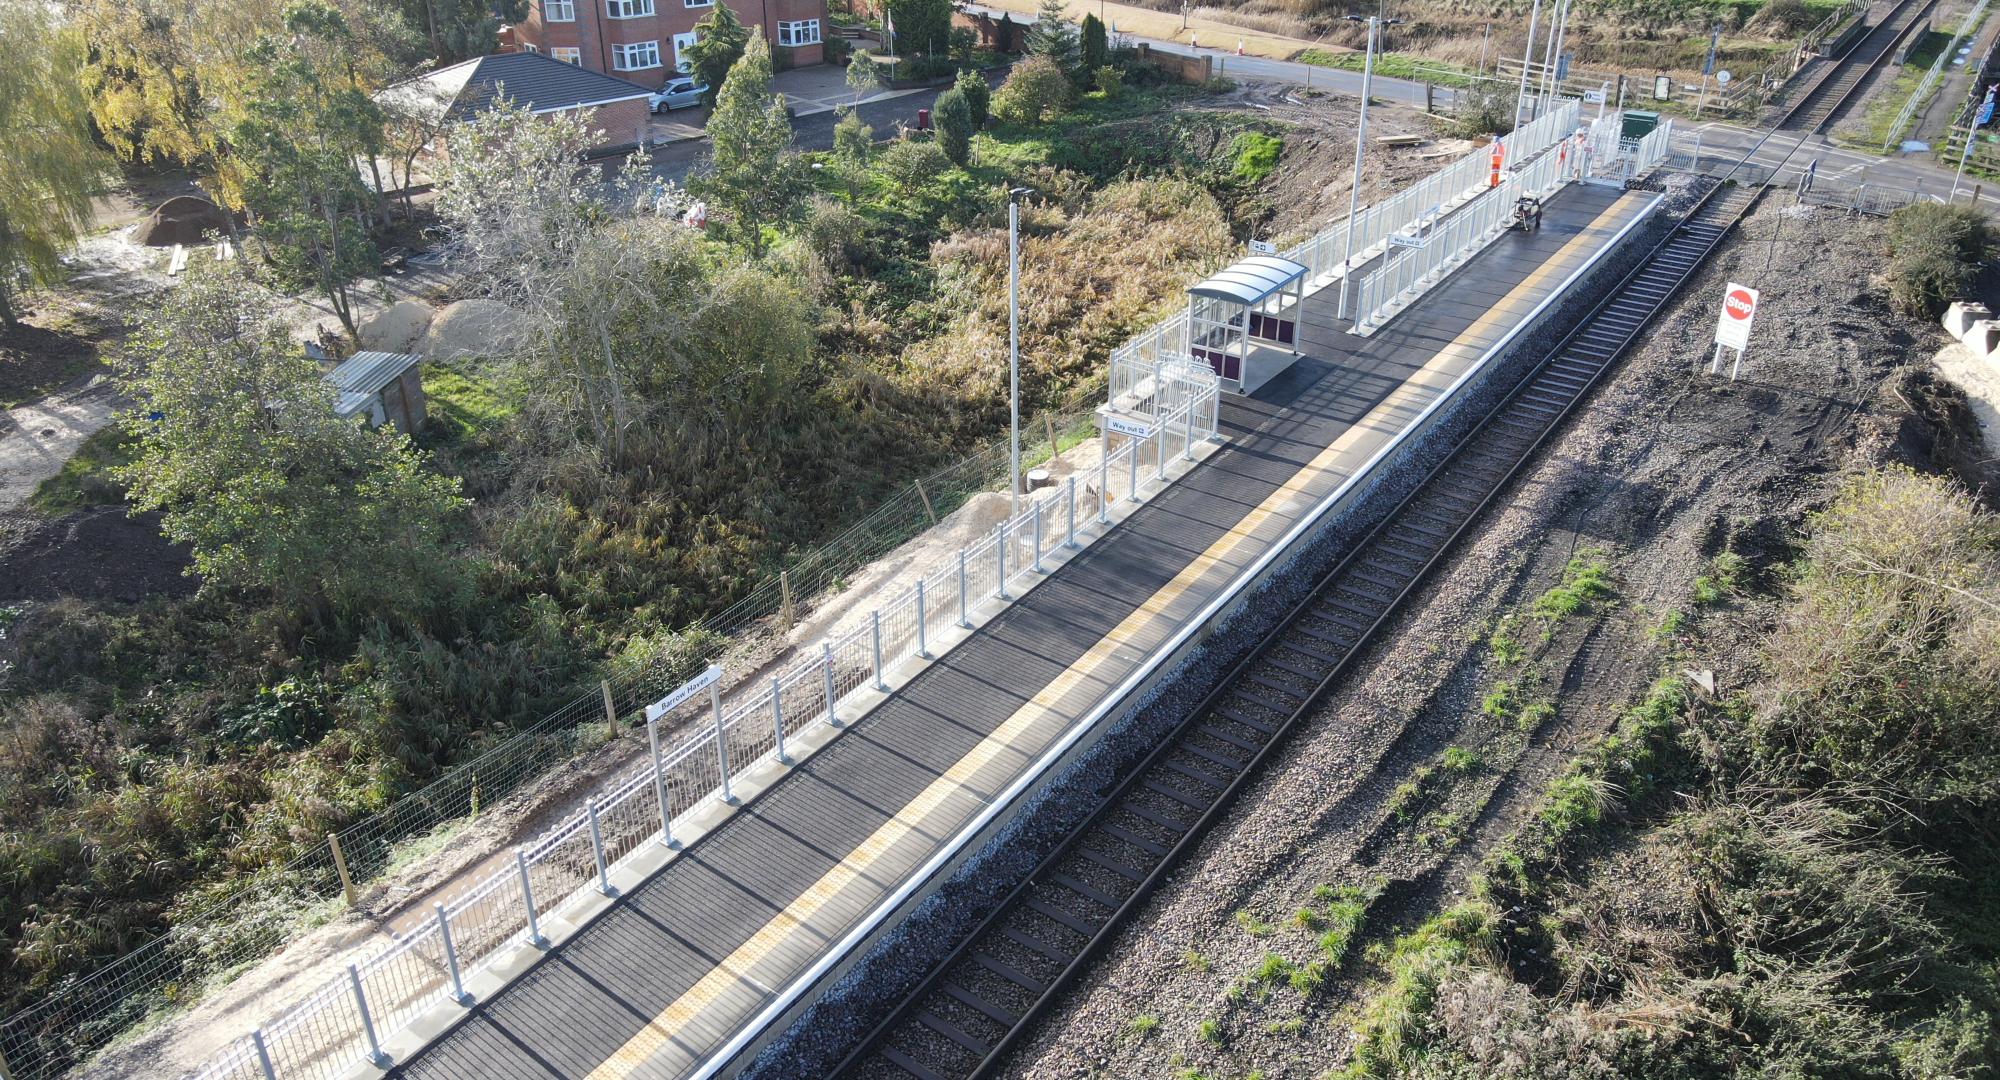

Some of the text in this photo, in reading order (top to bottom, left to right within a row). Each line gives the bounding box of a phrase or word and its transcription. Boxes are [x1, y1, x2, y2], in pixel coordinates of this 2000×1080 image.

[1726, 296, 1752, 313] Stop
[1112, 421, 1125, 431] Way
[661, 676, 709, 710] Barrow Haven
